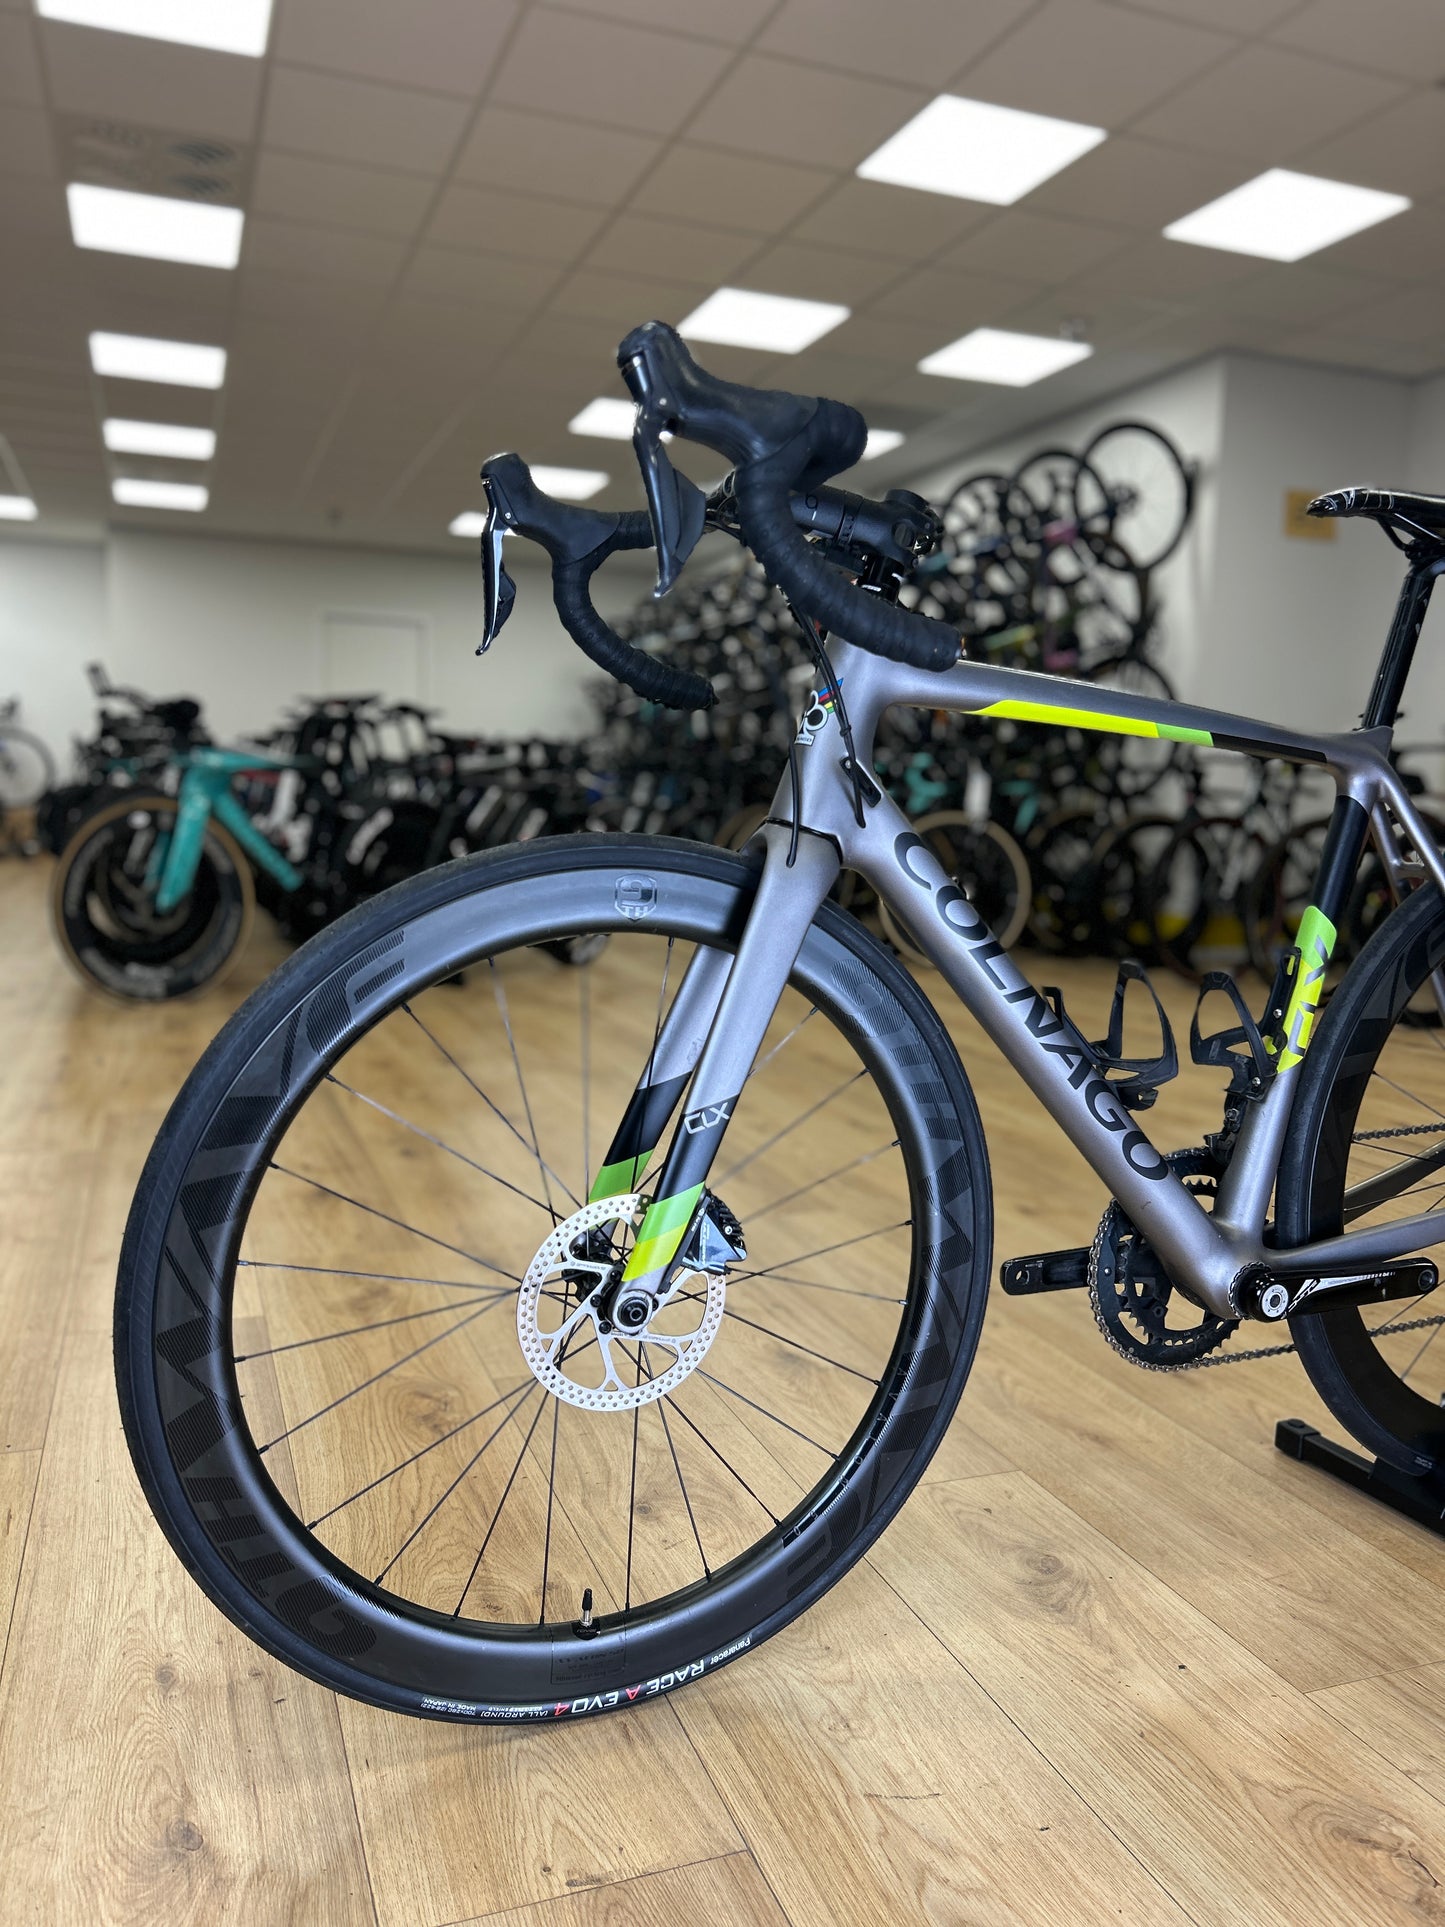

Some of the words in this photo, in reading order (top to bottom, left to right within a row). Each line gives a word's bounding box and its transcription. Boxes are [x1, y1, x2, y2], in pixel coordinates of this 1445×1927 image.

[894, 831, 1169, 1181] COLNAGO
[684, 1101, 730, 1135] CLX
[710, 1636, 752, 1665] Panaracer
[625, 1684, 641, 1700] A
[646, 1659, 705, 1695] RACE
